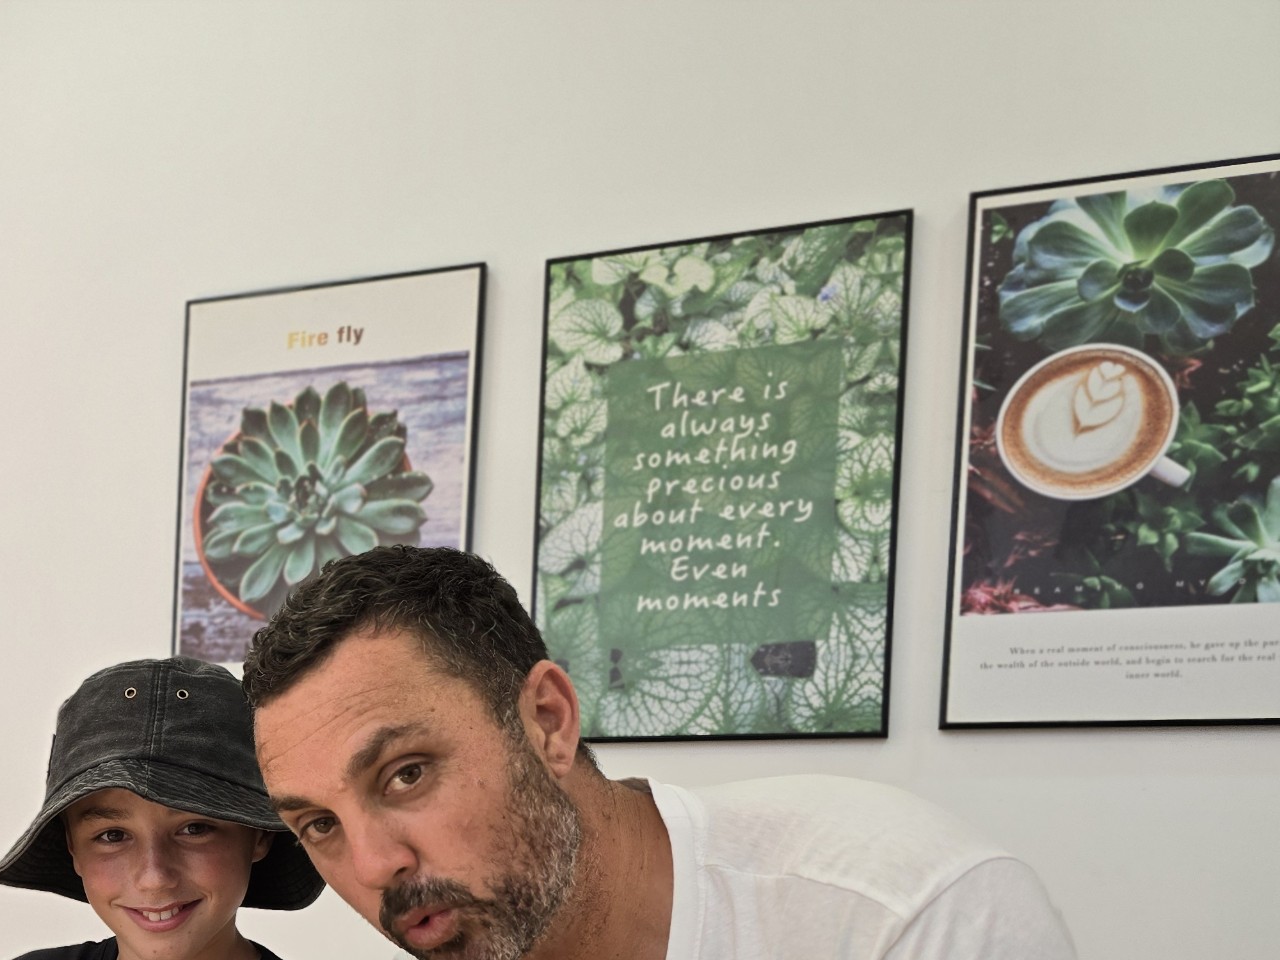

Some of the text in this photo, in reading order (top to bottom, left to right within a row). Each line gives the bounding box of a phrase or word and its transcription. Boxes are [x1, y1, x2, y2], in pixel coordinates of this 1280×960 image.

[286, 325, 364, 350] Fire fly
[647, 371, 788, 411] There is
[660, 410, 771, 439] always
[632, 433, 797, 471] something
[647, 464, 781, 503] precious
[613, 499, 813, 528] about every
[640, 522, 780, 555] moment.
[670, 556, 747, 581] Even
[636, 581, 782, 613] moments
[979, 661, 994, 670] the
[997, 660, 1026, 669] wealth
[1028, 659, 1039, 668] of
[1040, 659, 1054, 668] the
[1125, 657, 1142, 666] and
[1145, 656, 1171, 667] begin
[1174, 656, 1184, 664] to
[1187, 654, 1217, 664] search
[1220, 653, 1235, 662] for
[1238, 653, 1253, 662] the
[1256, 652, 1276, 661] real
[1009, 646, 1036, 655] When
[1046, 646, 1065, 654] real
[1067, 645, 1104, 653] moment
[1106, 644, 1117, 652] of
[1204, 642, 1225, 651] gave
[1228, 641, 1241, 650] up
[1244, 638, 1259, 647] the
[1125, 671, 1150, 679] inner
